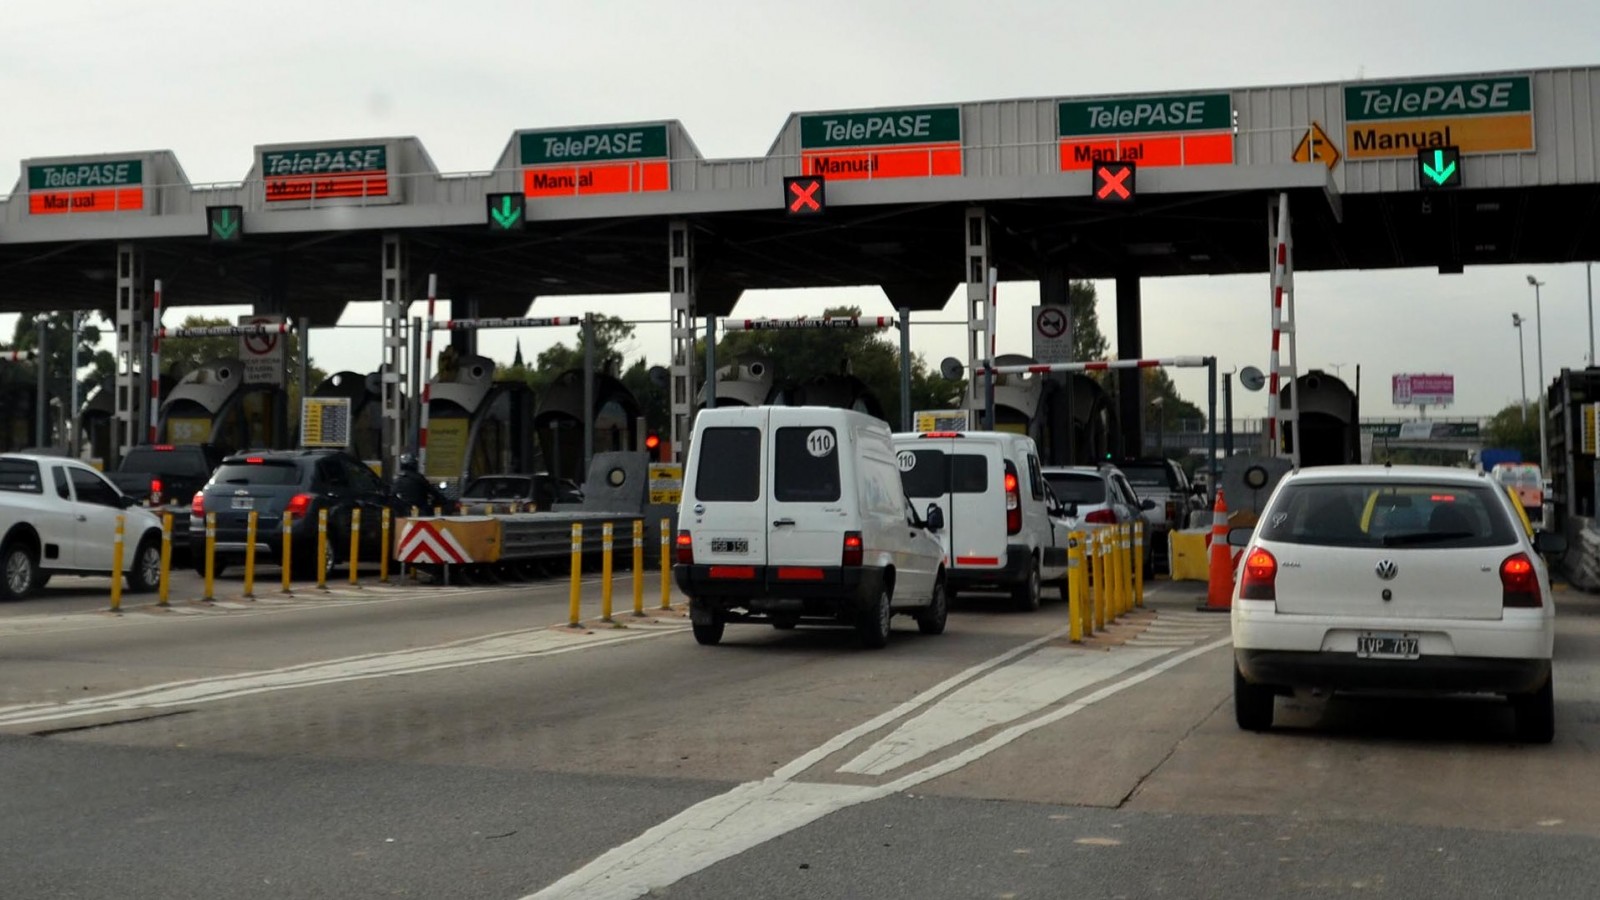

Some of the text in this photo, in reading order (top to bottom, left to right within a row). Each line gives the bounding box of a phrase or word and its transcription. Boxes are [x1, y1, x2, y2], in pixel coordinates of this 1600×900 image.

[1361, 82, 1514, 114] TelePASE
[1087, 102, 1205, 128] TelePASE
[823, 115, 931, 141] TelePASE
[1353, 126, 1452, 151] Manual
[544, 133, 644, 158] TelePASE
[1074, 144, 1143, 163] Manual
[268, 150, 381, 173] TelePASE
[815, 155, 878, 174] Manual
[43, 164, 129, 187] TelePASE
[534, 171, 593, 188] Manual
[44, 193, 95, 208] Manual
[810, 435, 830, 451] 110
[899, 455, 914, 467] 110
[1361, 639, 1384, 652] IVP
